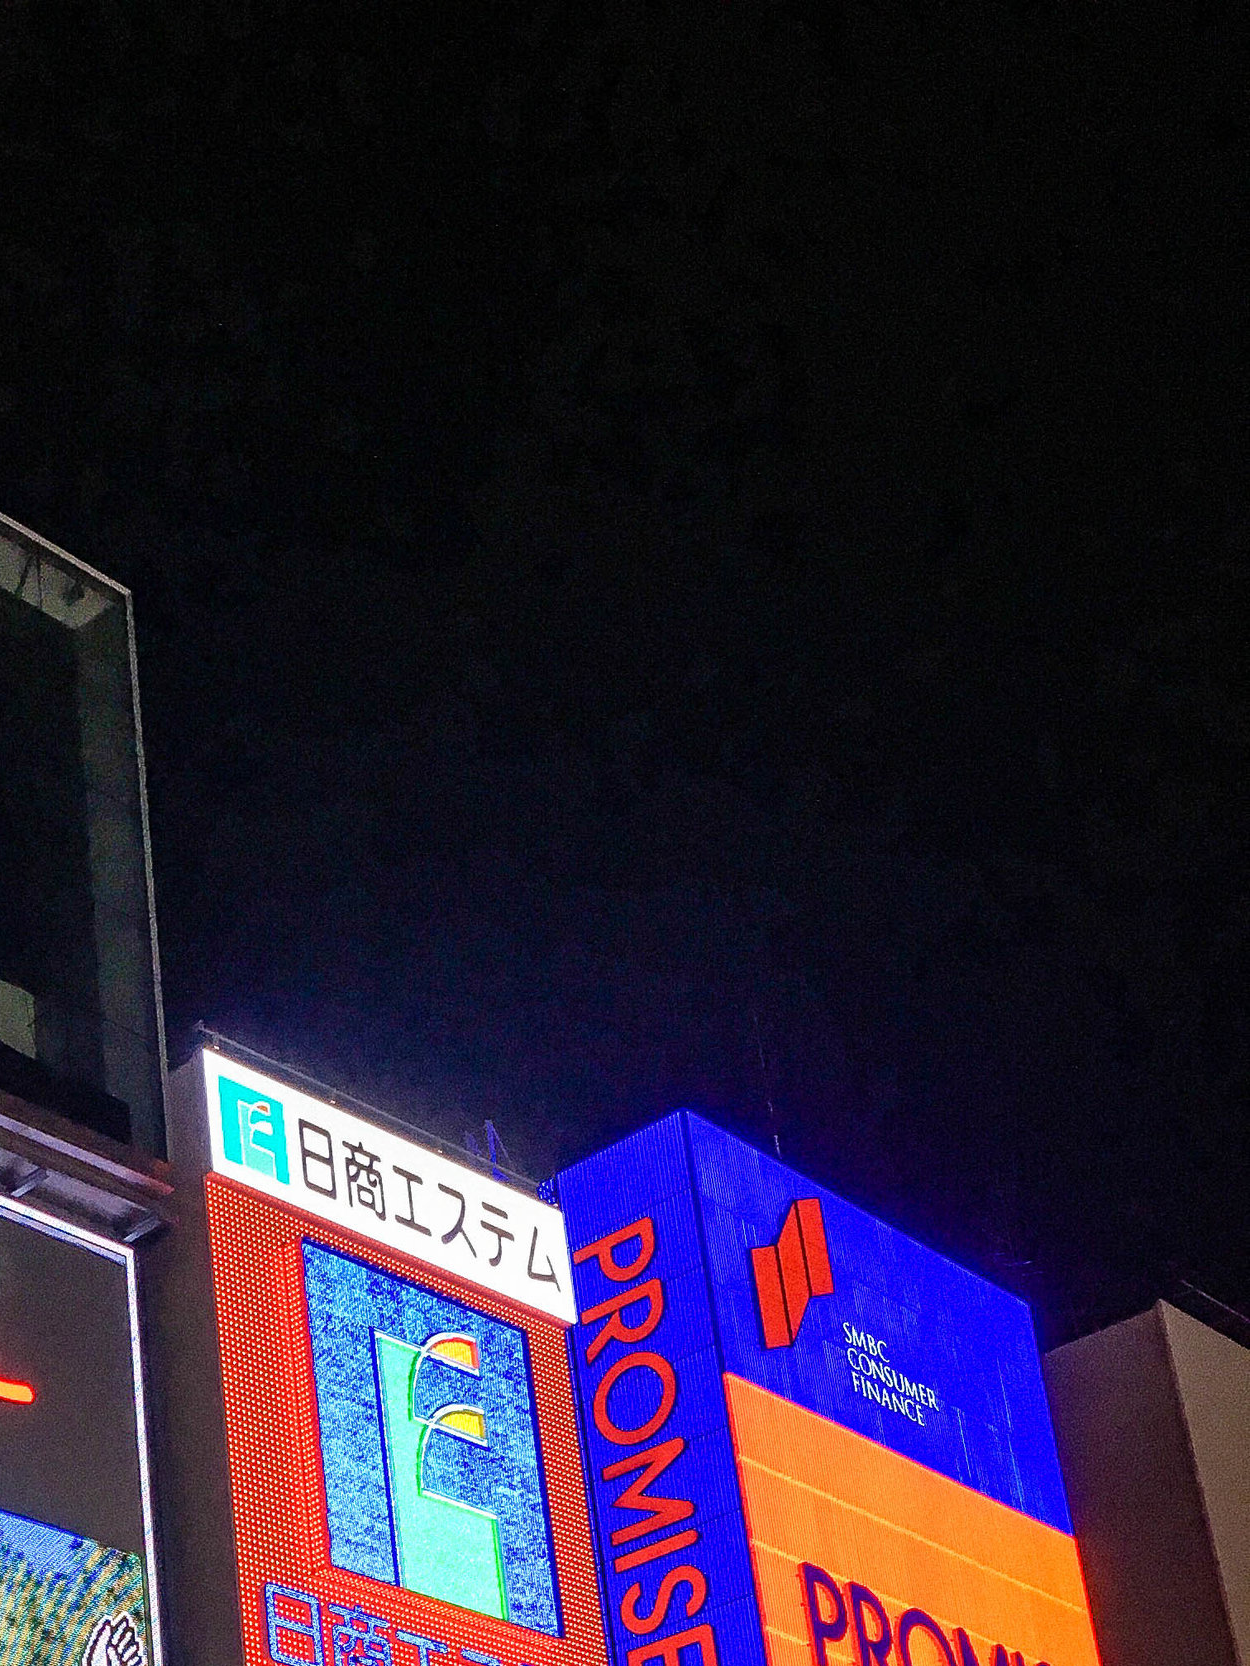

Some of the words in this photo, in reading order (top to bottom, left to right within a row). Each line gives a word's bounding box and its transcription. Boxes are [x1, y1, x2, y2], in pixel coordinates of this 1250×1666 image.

[298, 1118, 562, 1294] 日商エステム
[842, 1321, 890, 1363] SMBC
[847, 1347, 940, 1412] CONSUMER
[851, 1371, 926, 1427] FINANCE
